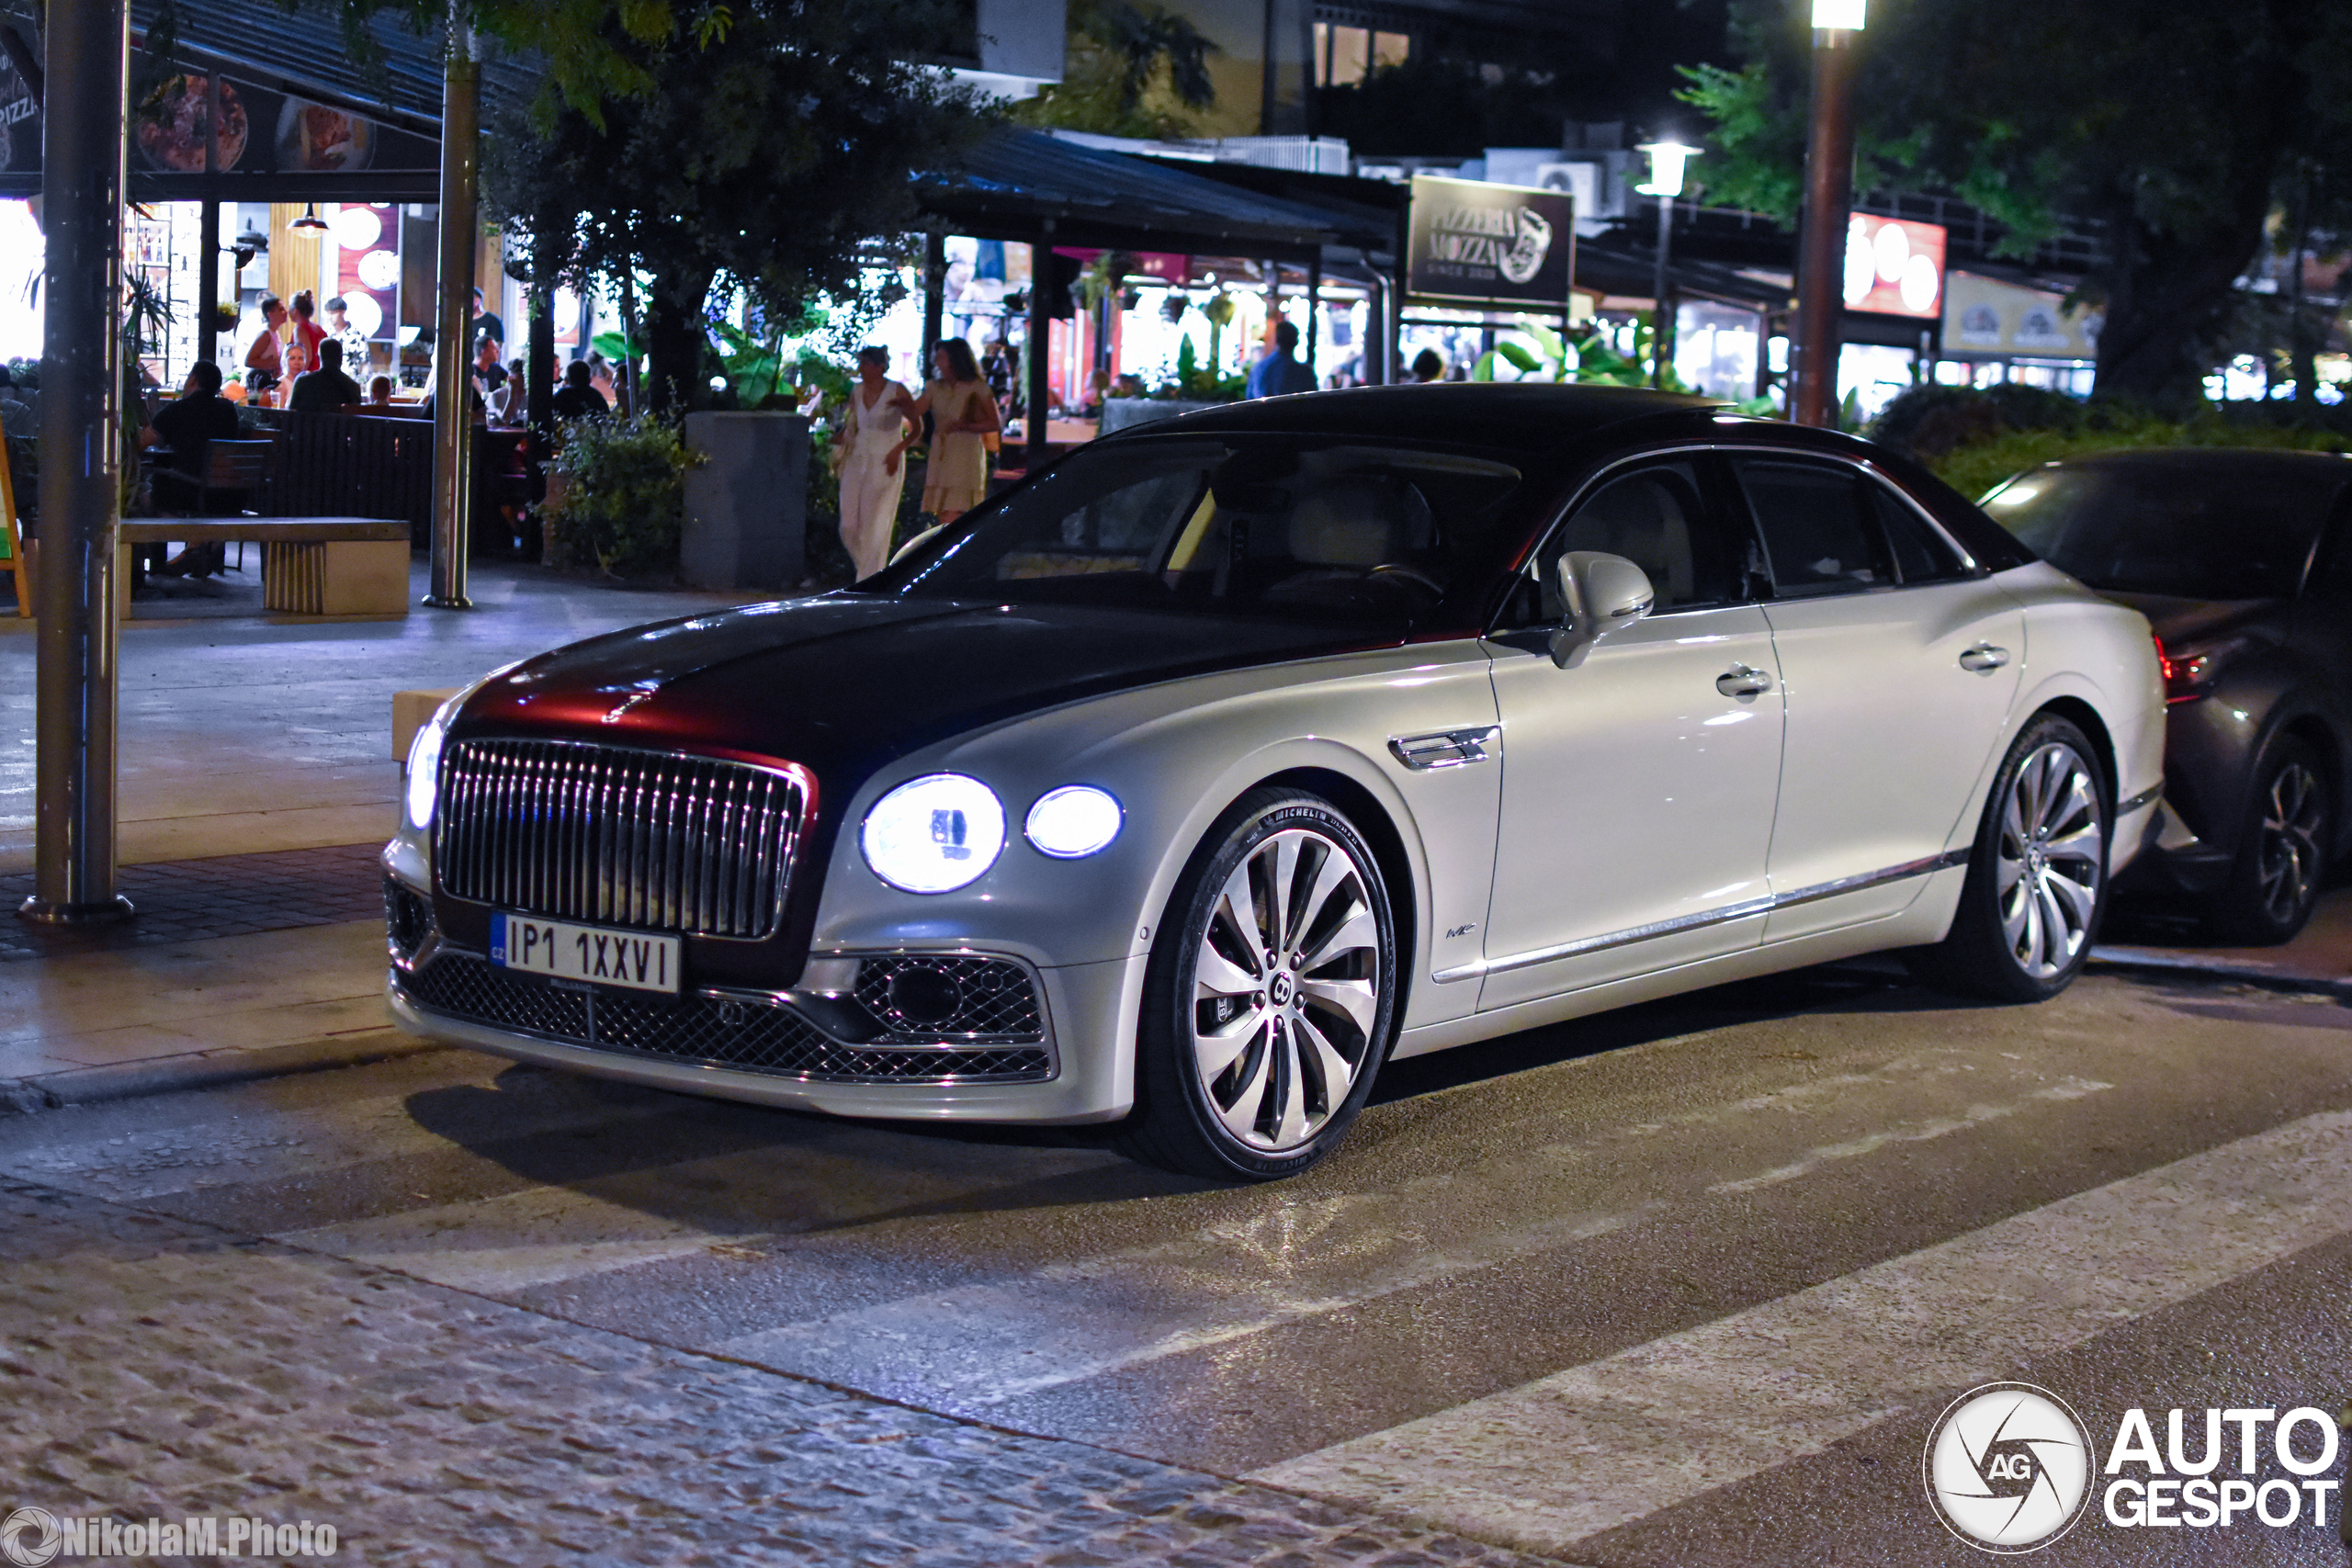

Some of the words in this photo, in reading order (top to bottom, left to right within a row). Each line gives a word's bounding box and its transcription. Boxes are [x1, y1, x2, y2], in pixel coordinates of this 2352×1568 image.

[1429, 207, 1516, 237] PIZZERIA
[1275, 808, 1327, 821] MICHELIN
[492, 946, 504, 960] CZ
[512, 920, 555, 969] IP1
[576, 932, 665, 986] 1XXVI
